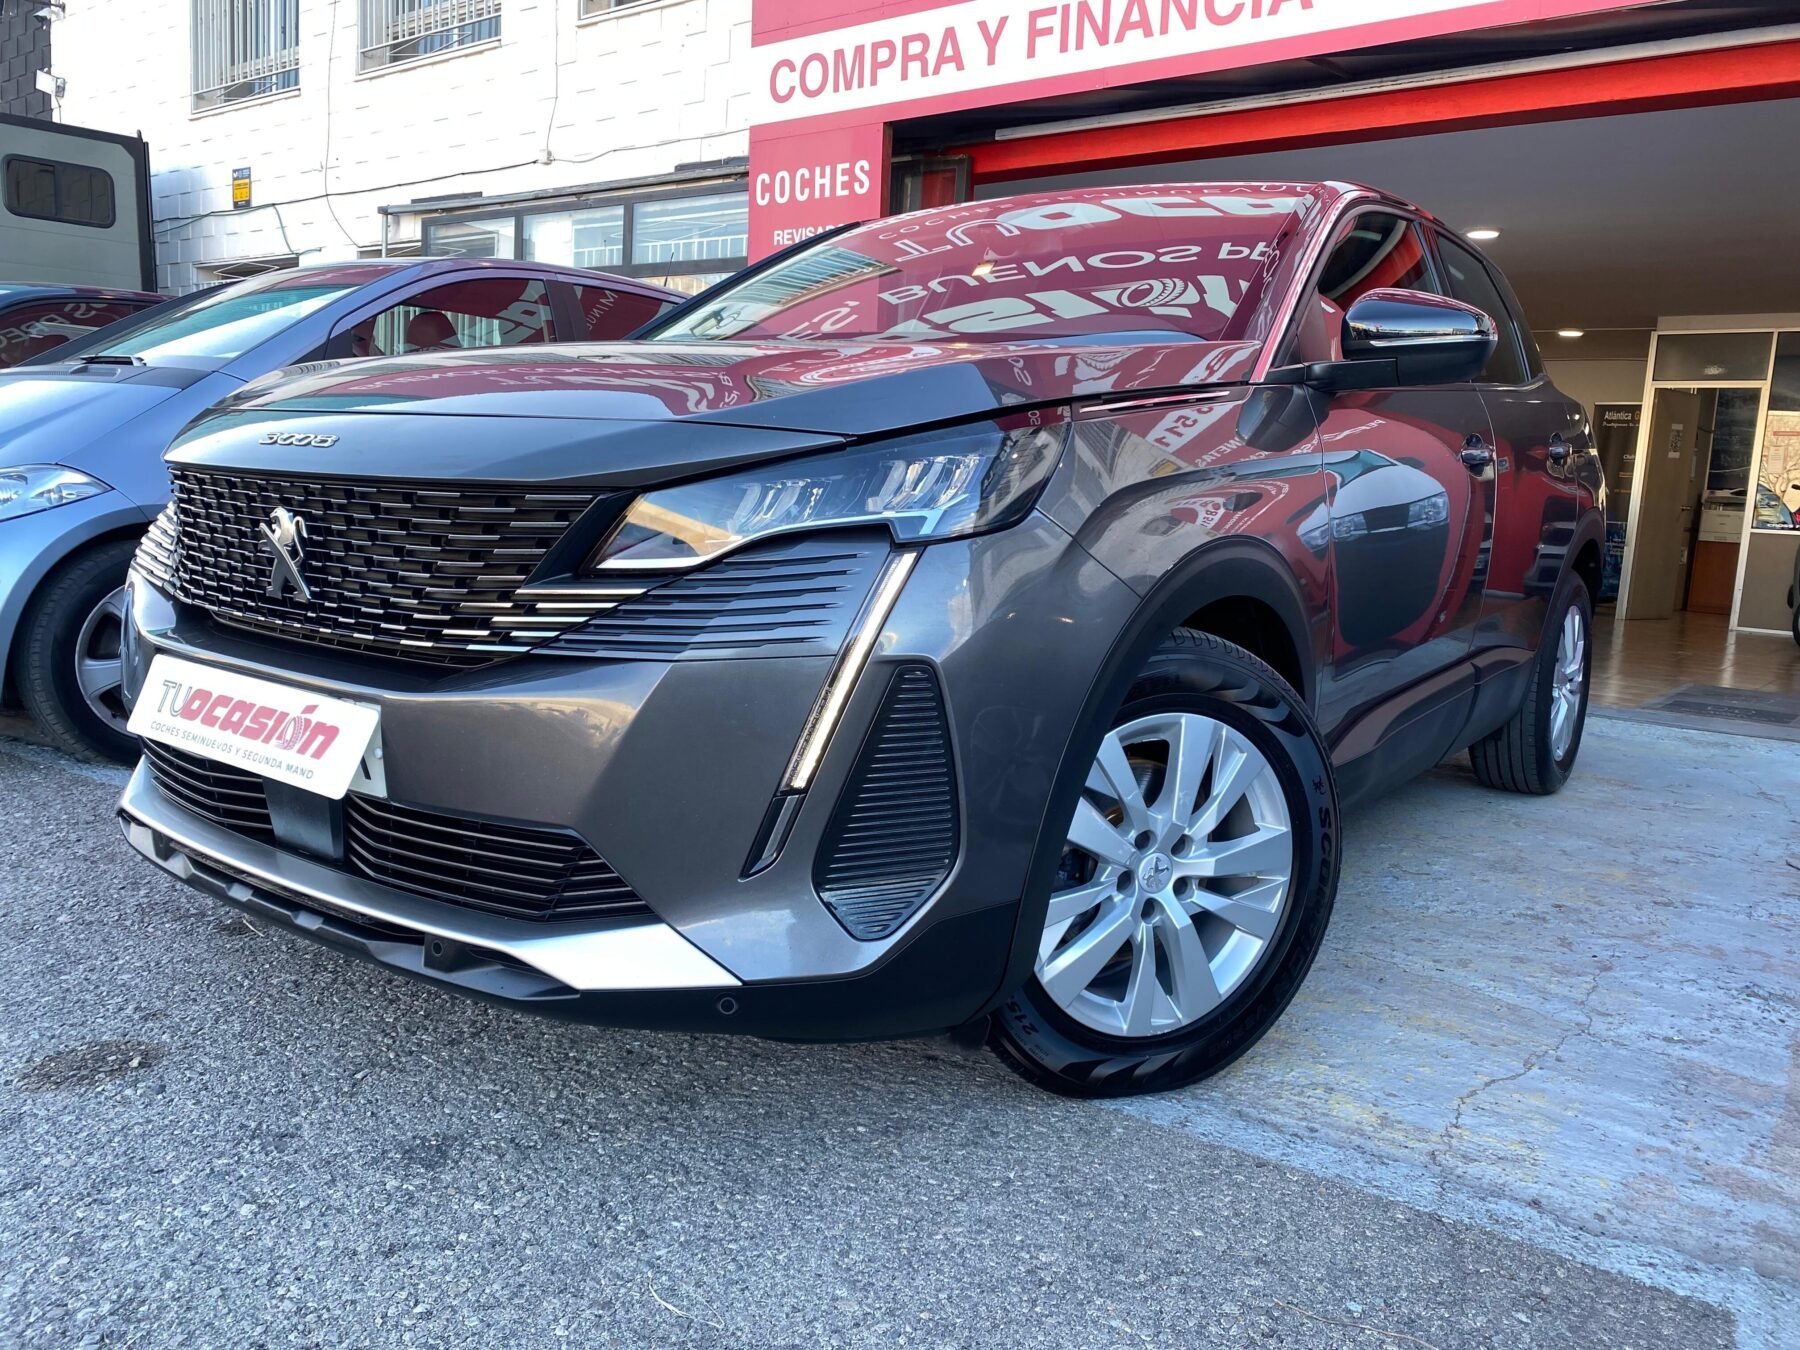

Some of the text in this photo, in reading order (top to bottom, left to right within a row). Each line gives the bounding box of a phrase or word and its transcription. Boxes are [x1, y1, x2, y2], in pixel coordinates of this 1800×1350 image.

[769, 26, 965, 103] COMPRA
[976, 15, 1009, 66] Y
[756, 160, 870, 206] COCHES
[773, 223, 845, 245] REVISA
[258, 432, 340, 448] 3008
[150, 720, 314, 780] COCHES SEMINUEVOS Y SEGUNDA MANO
